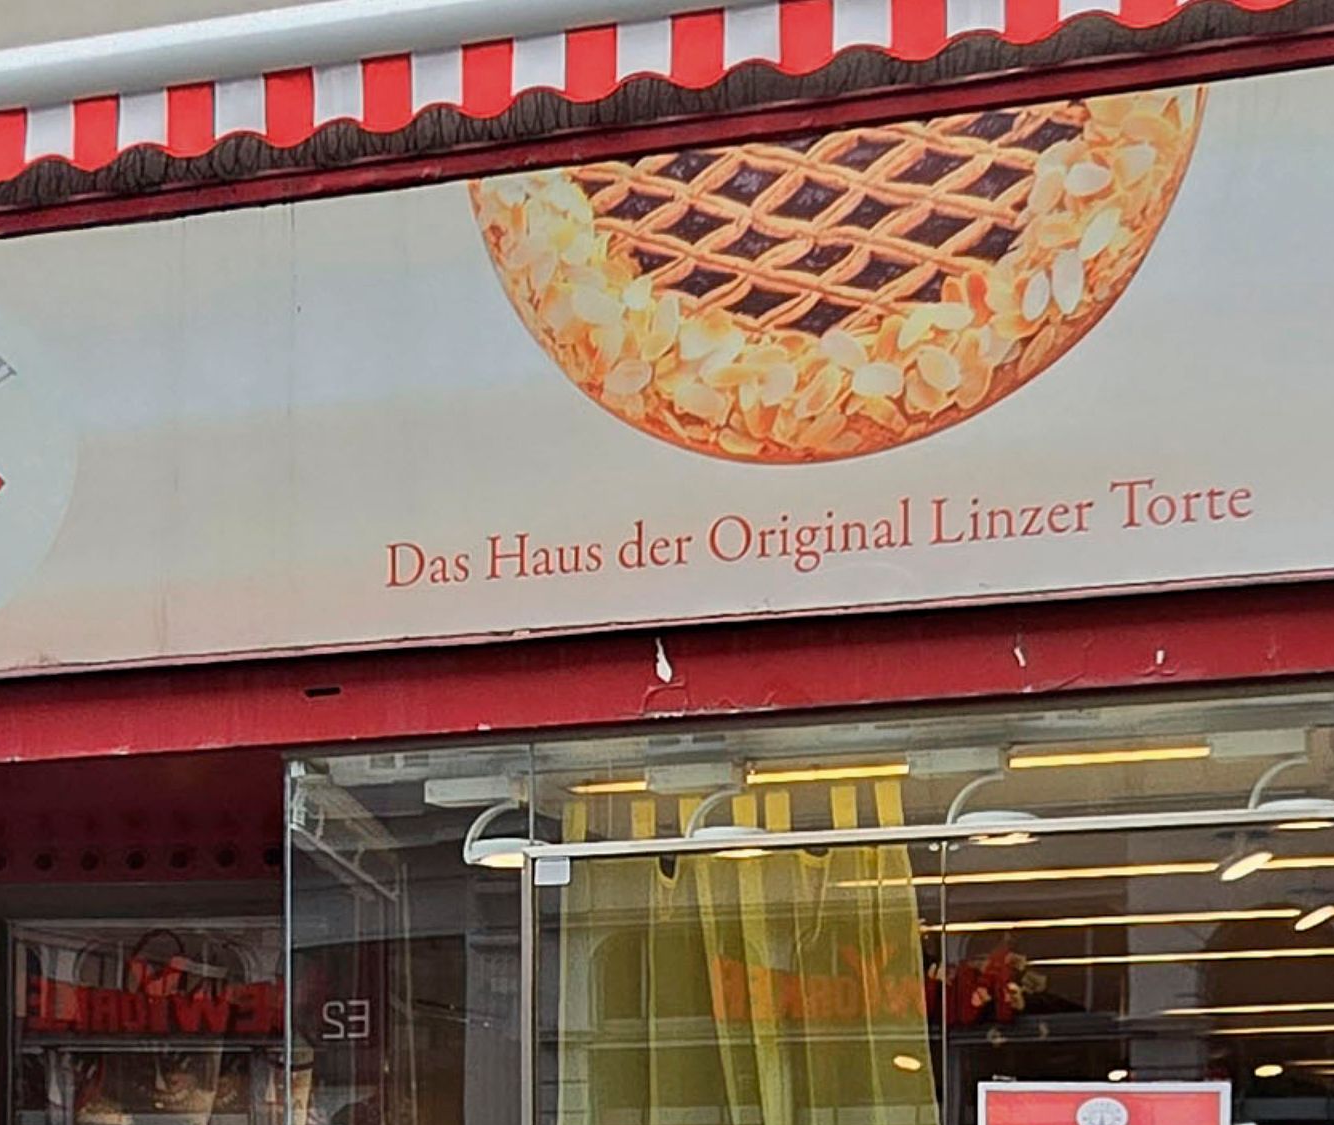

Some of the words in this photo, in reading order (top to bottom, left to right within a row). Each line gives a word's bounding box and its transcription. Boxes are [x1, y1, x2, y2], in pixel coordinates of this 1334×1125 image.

[385, 541, 470, 588] Das
[486, 532, 604, 581] Haus
[618, 519, 694, 572] der
[708, 497, 914, 573] Original
[931, 495, 1095, 546] Linzer
[1110, 477, 1254, 530] Torte
